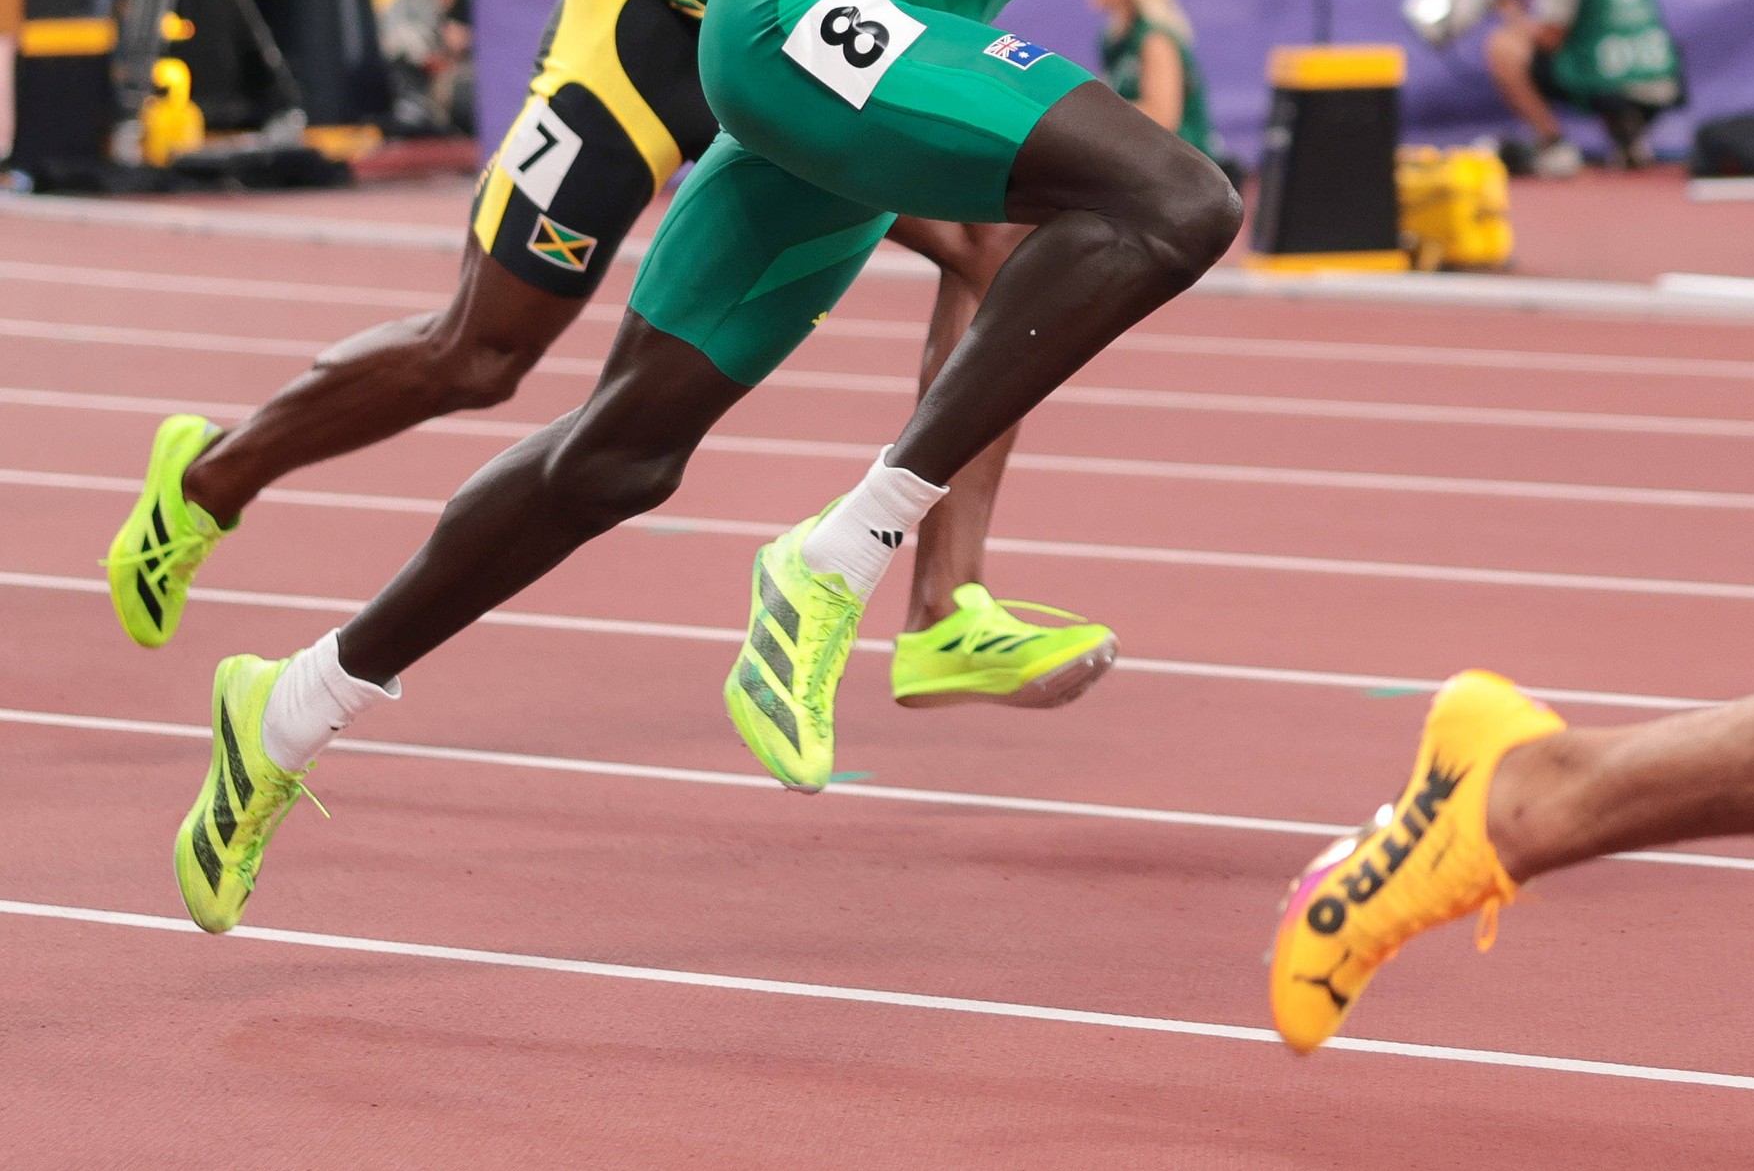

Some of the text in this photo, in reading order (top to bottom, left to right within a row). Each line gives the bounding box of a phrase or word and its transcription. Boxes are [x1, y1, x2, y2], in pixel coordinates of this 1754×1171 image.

[819, 5, 891, 69] 8
[517, 122, 560, 174] 7
[1307, 755, 1471, 936] NITRO
